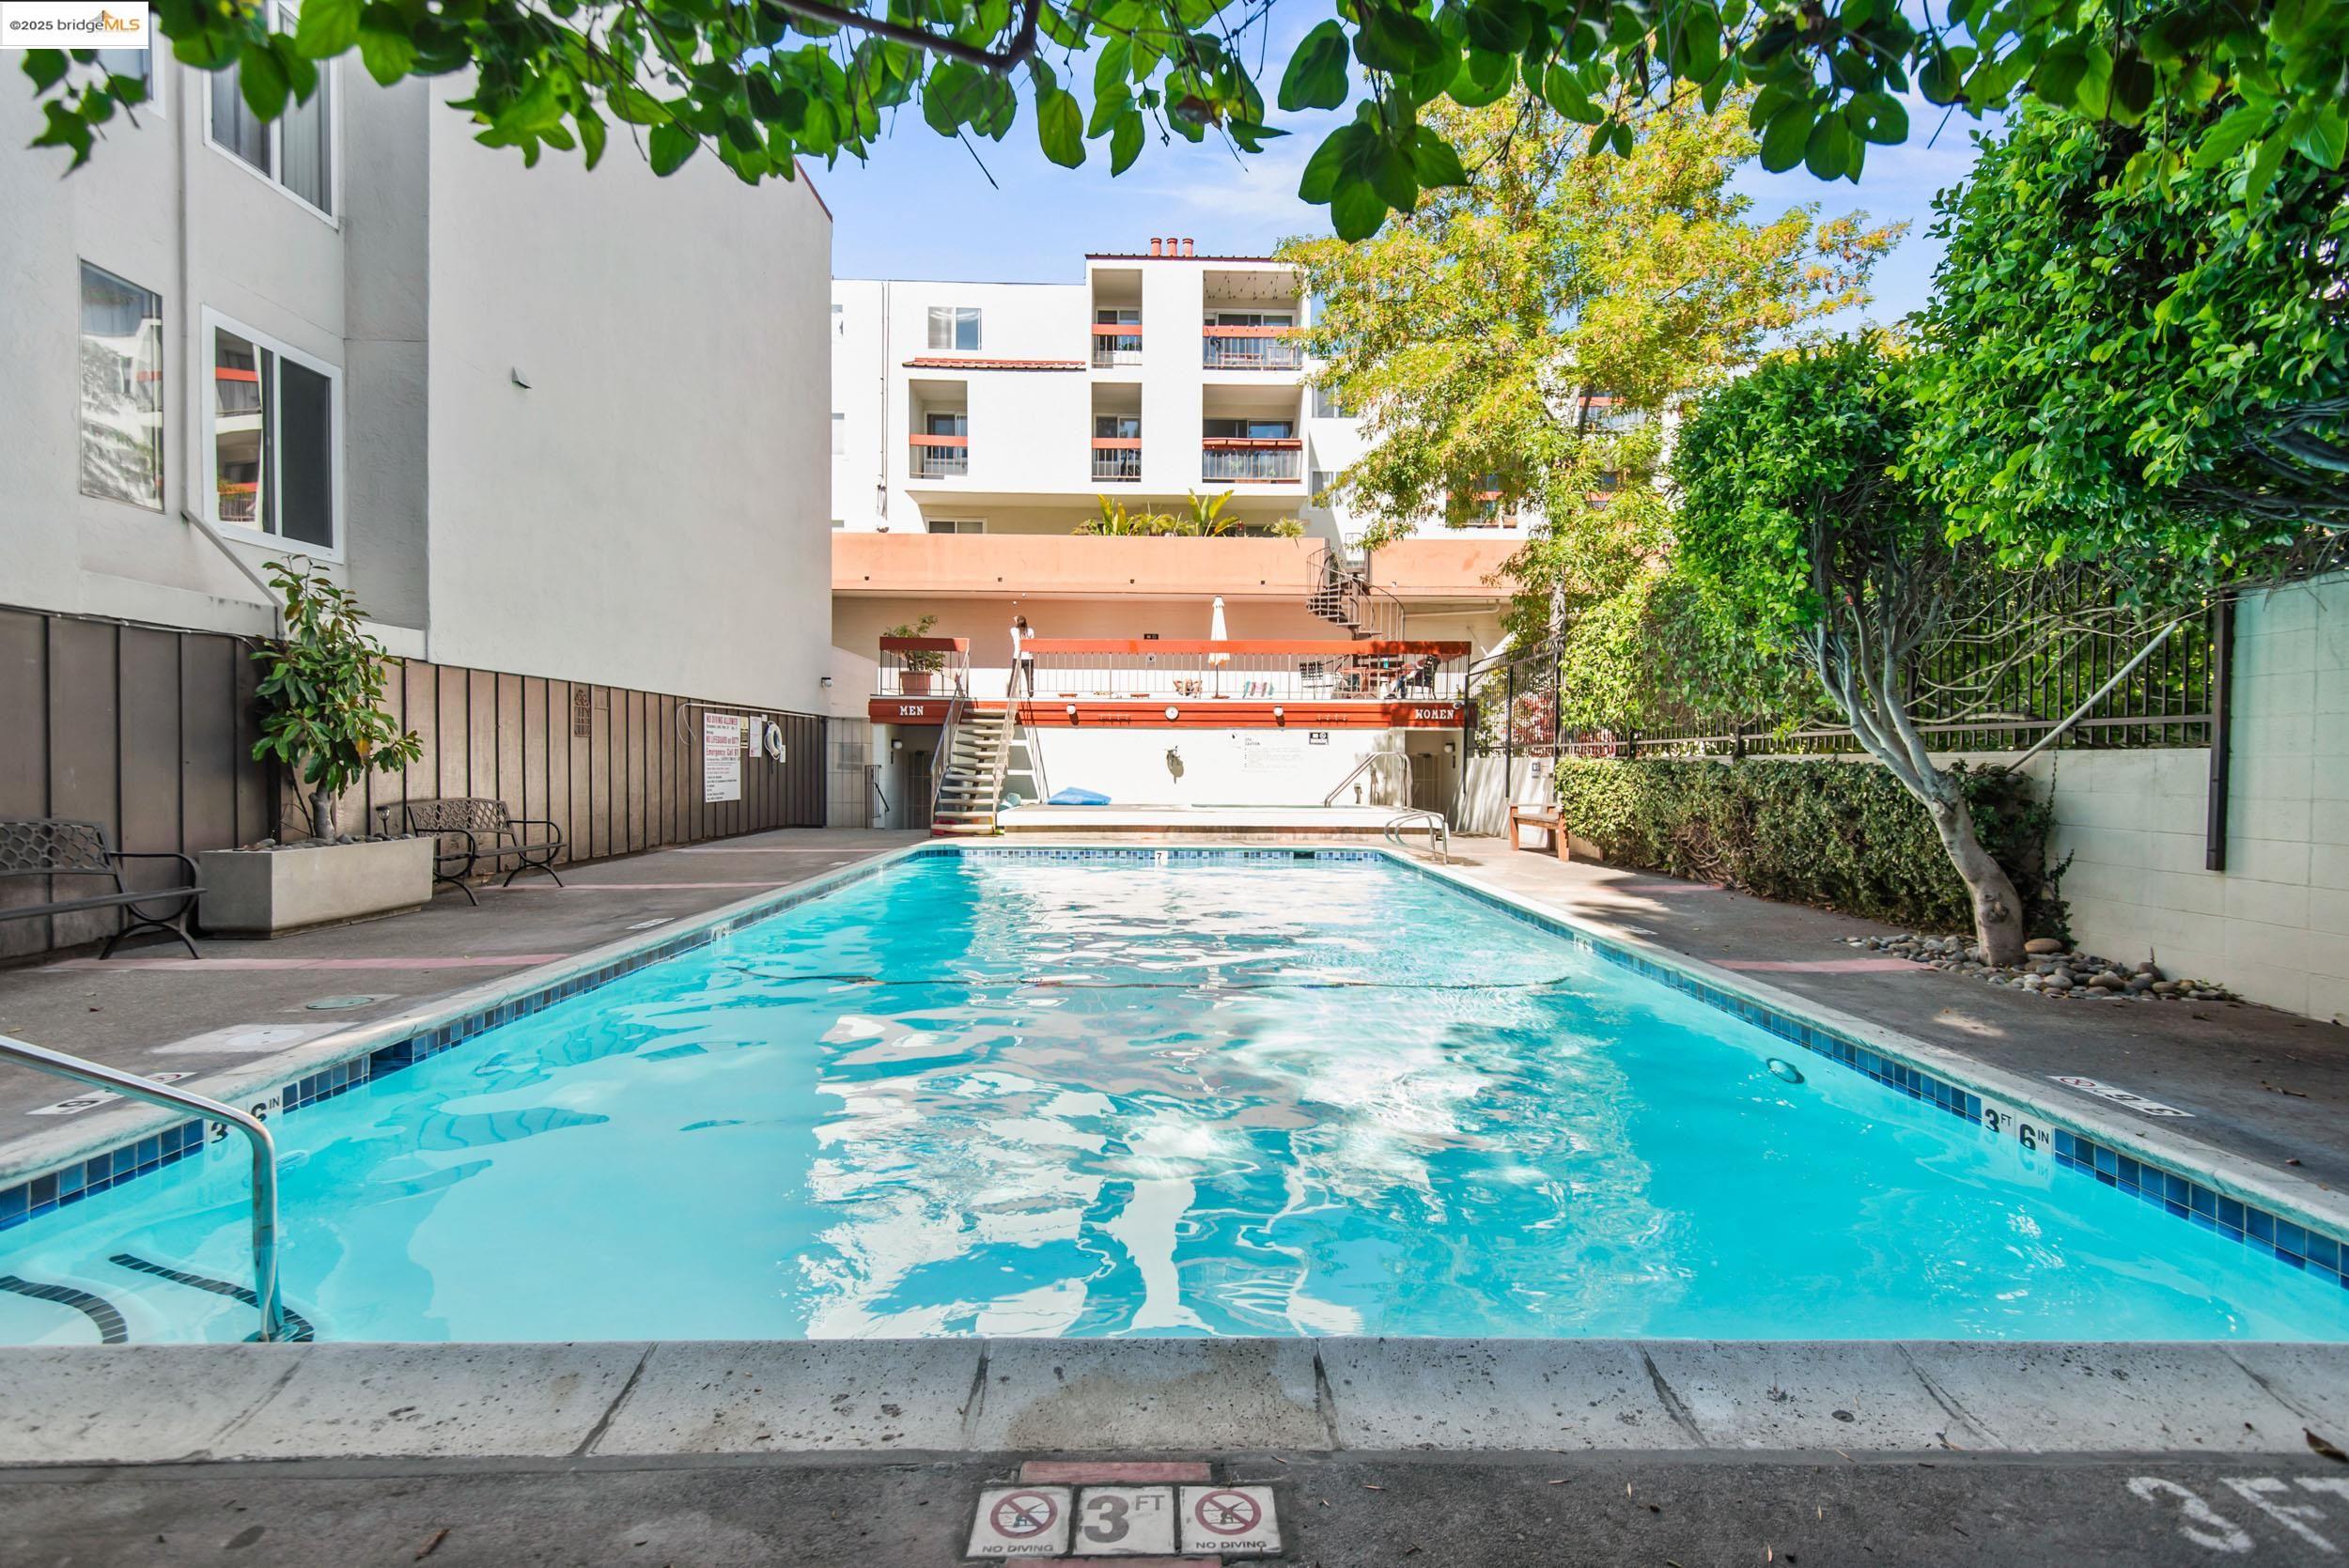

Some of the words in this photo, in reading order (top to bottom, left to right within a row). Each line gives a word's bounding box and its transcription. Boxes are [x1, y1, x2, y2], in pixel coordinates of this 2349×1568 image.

[899, 705, 925, 716] MEN
[1414, 708, 1455, 721] WOMEN
[210, 1121, 229, 1143] 3
[269, 1096, 280, 1109] IN
[1984, 1108, 1999, 1133] 3
[2000, 1112, 2013, 1126] FT
[2019, 1124, 2036, 1151] 6
[2037, 1129, 2049, 1144] IN
[1083, 1494, 1129, 1544] 3
[1135, 1495, 1165, 1511] FT
[2126, 1476, 2255, 1554] 3
[982, 1545, 1003, 1554] NO
[1007, 1544, 1053, 1553] DIVING
[1196, 1541, 1217, 1549] NO
[1221, 1540, 1267, 1549] DIVING
